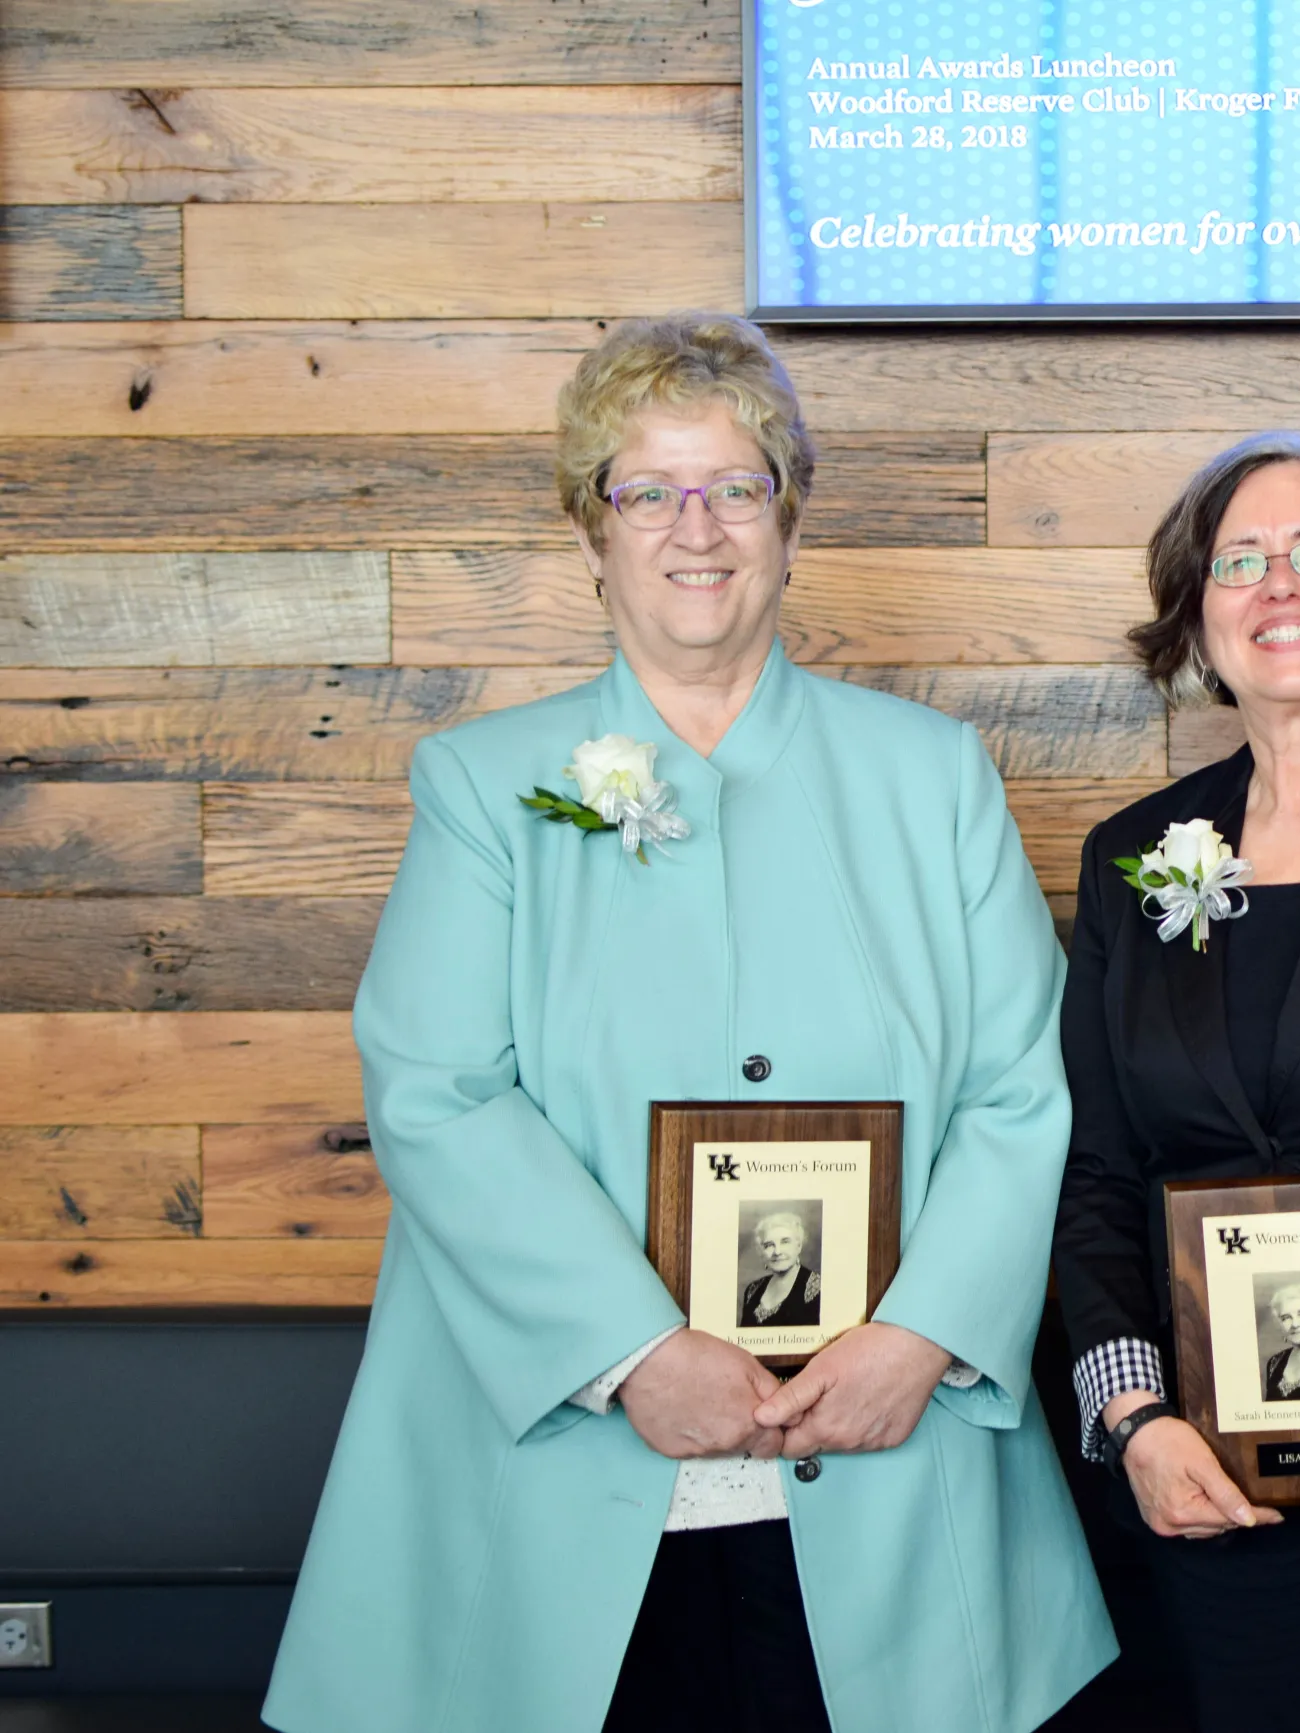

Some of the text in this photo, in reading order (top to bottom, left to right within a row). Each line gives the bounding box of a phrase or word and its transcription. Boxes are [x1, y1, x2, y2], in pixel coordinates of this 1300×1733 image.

[807, 53, 1177, 80] Annual Awards Luncheon
[808, 88, 953, 115] Woodford
[961, 90, 1075, 113] Reserve
[1082, 86, 1150, 112] Club
[1174, 88, 1277, 117] Kroger
[808, 124, 1028, 152] March 28, 2018
[809, 212, 1042, 256] Celebrating
[1047, 222, 1188, 247] women
[1189, 210, 1256, 255] for
[707, 1153, 857, 1181] UK Women's Forum
[1216, 1226, 1251, 1254] UK
[737, 1335, 775, 1346] Bennett
[778, 1334, 815, 1344] Holmes
[1234, 1411, 1261, 1422] Sarah
